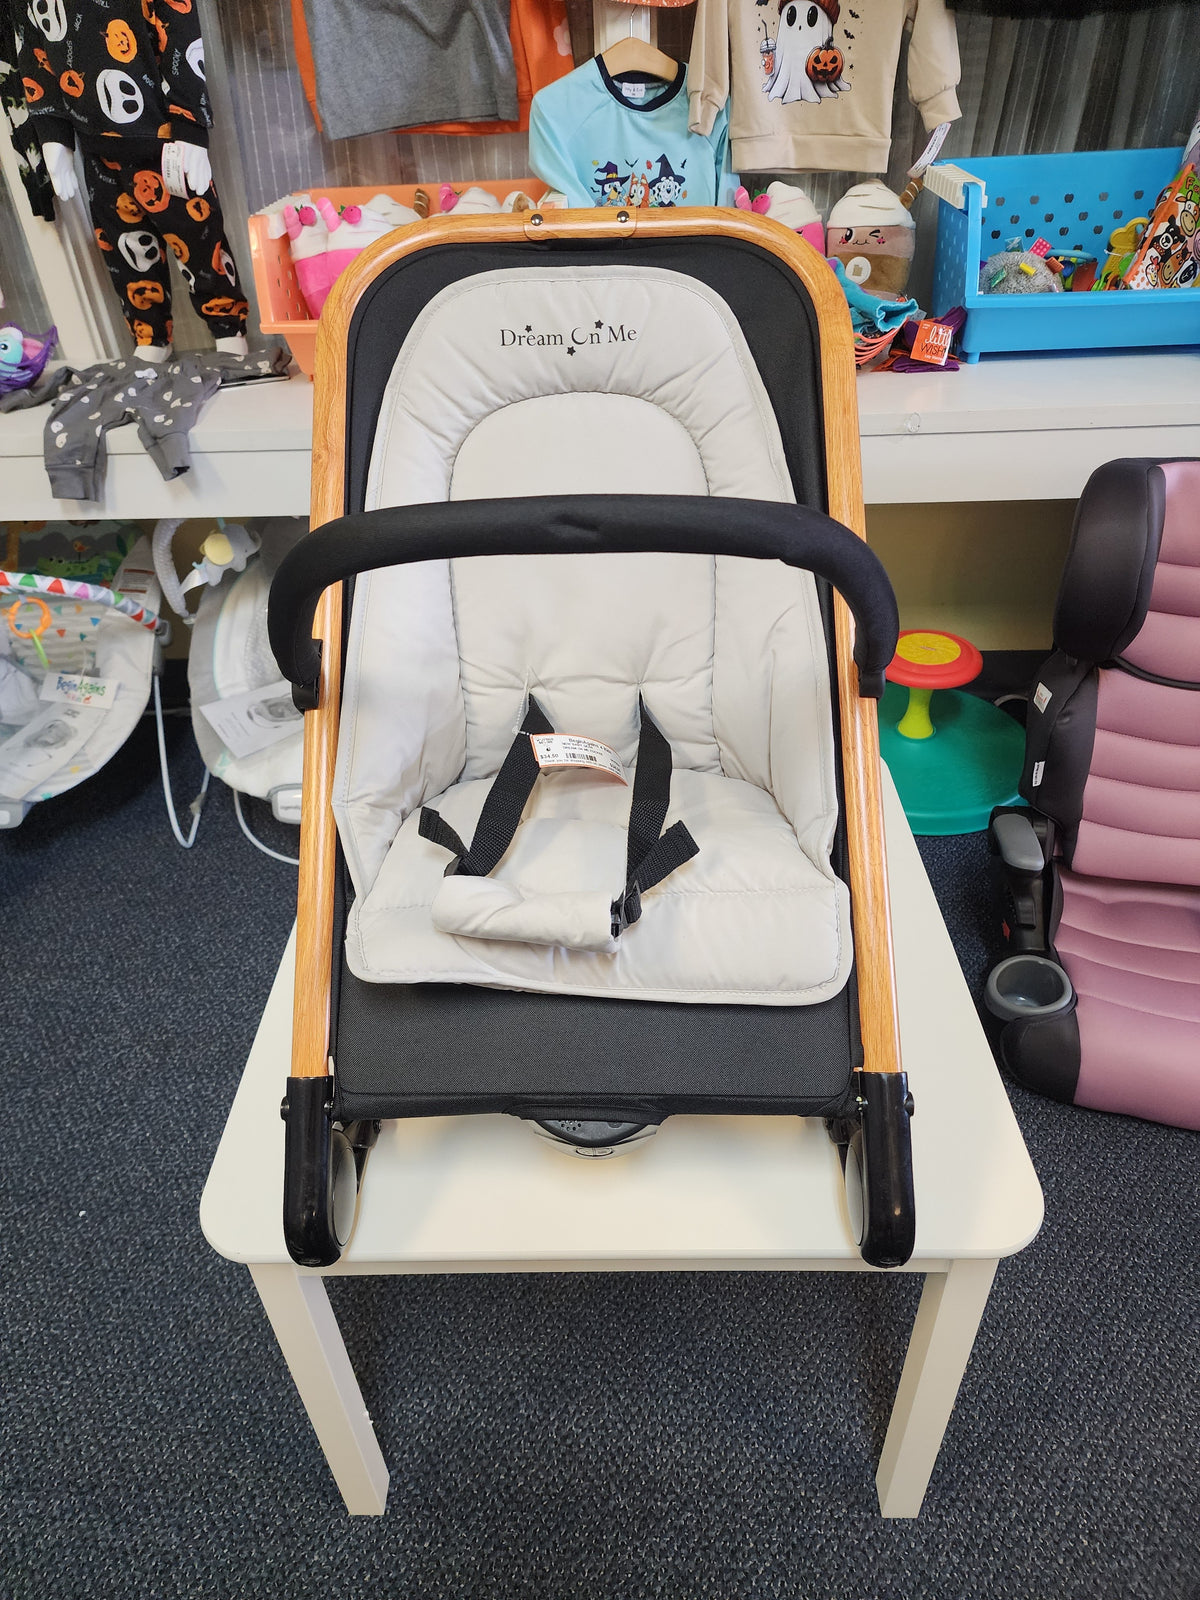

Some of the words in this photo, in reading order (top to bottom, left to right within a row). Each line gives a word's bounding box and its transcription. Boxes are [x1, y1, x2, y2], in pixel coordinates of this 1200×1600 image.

[171, 48, 183, 76] SPOOKY
[500, 328, 564, 347] Dream
[607, 324, 637, 344] Me
